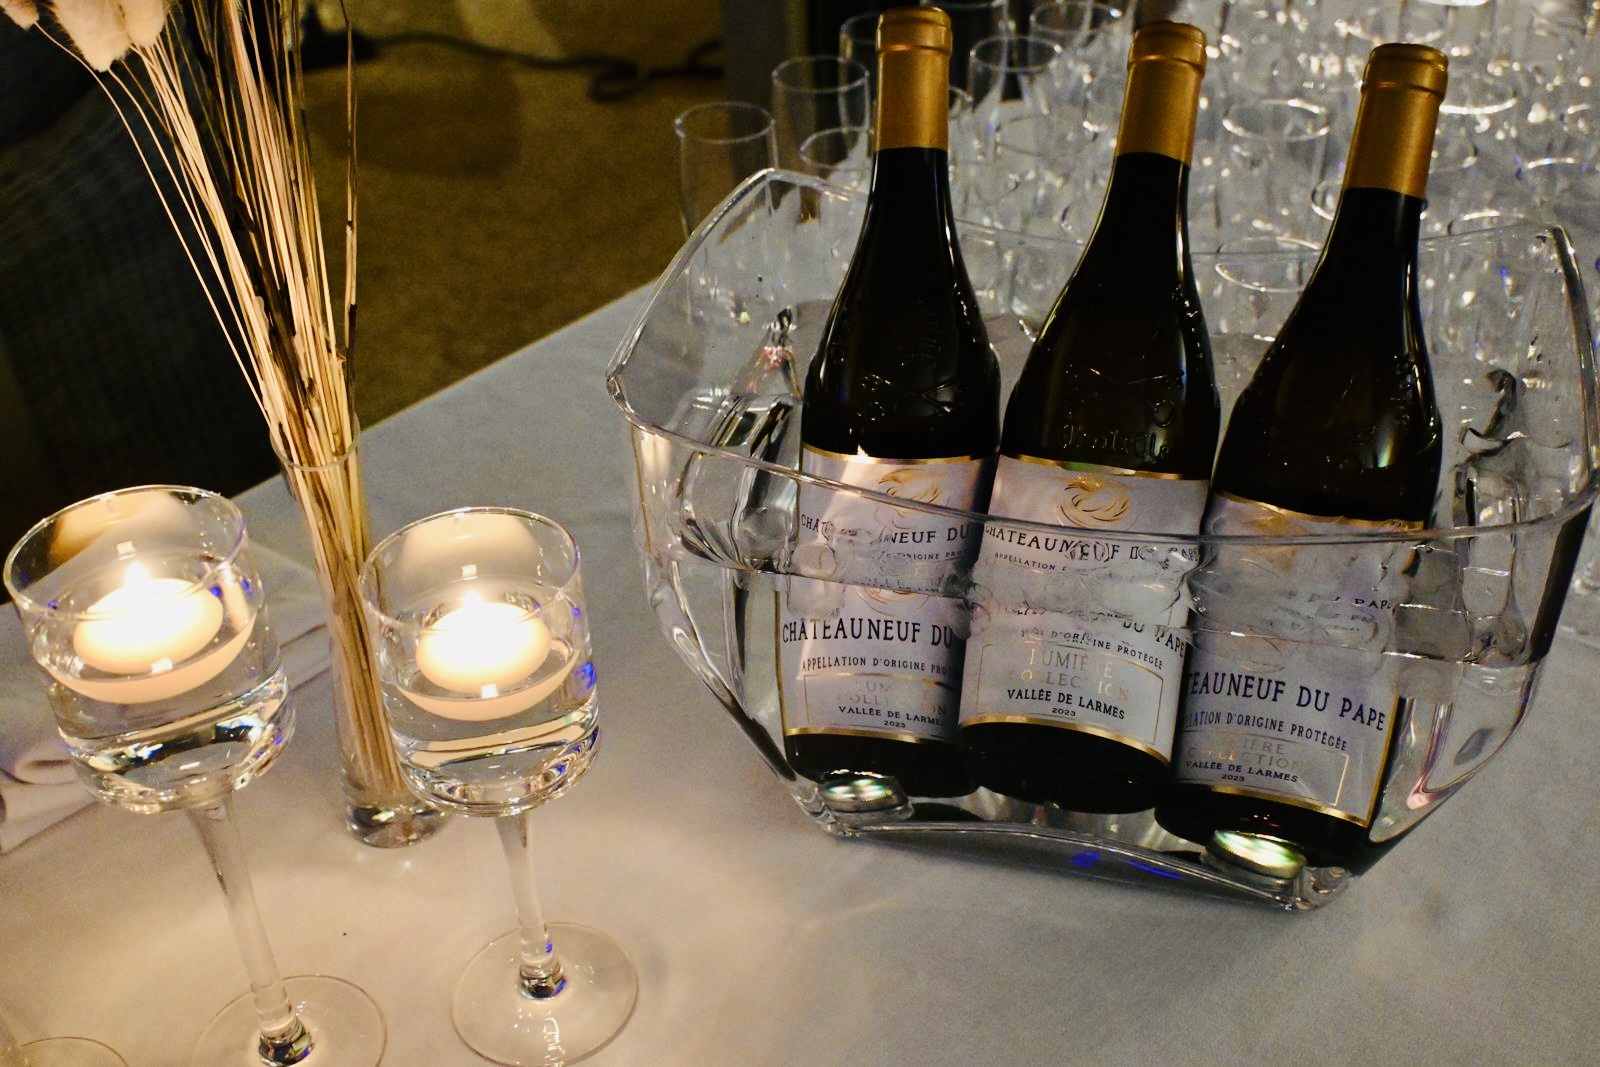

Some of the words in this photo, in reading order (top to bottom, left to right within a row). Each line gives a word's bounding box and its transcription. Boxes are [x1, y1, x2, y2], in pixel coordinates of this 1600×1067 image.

[947, 524, 969, 541] DU
[931, 624, 953, 648] DU
[802, 656, 866, 671] APPELLATION
[873, 658, 925, 671] D'ORIGINE
[888, 709, 901, 718] DE
[1051, 707, 1076, 717] 2023
[1058, 692, 1073, 705] DE
[1080, 696, 1125, 720] LARMES
[1296, 686, 1330, 712] DU
[1339, 697, 1386, 731] PAPE
[1227, 712, 1284, 733] D'ORIGINE
[1221, 774, 1245, 782] 2023
[1228, 763, 1242, 773] DE
[1248, 767, 1298, 783] LARMES
